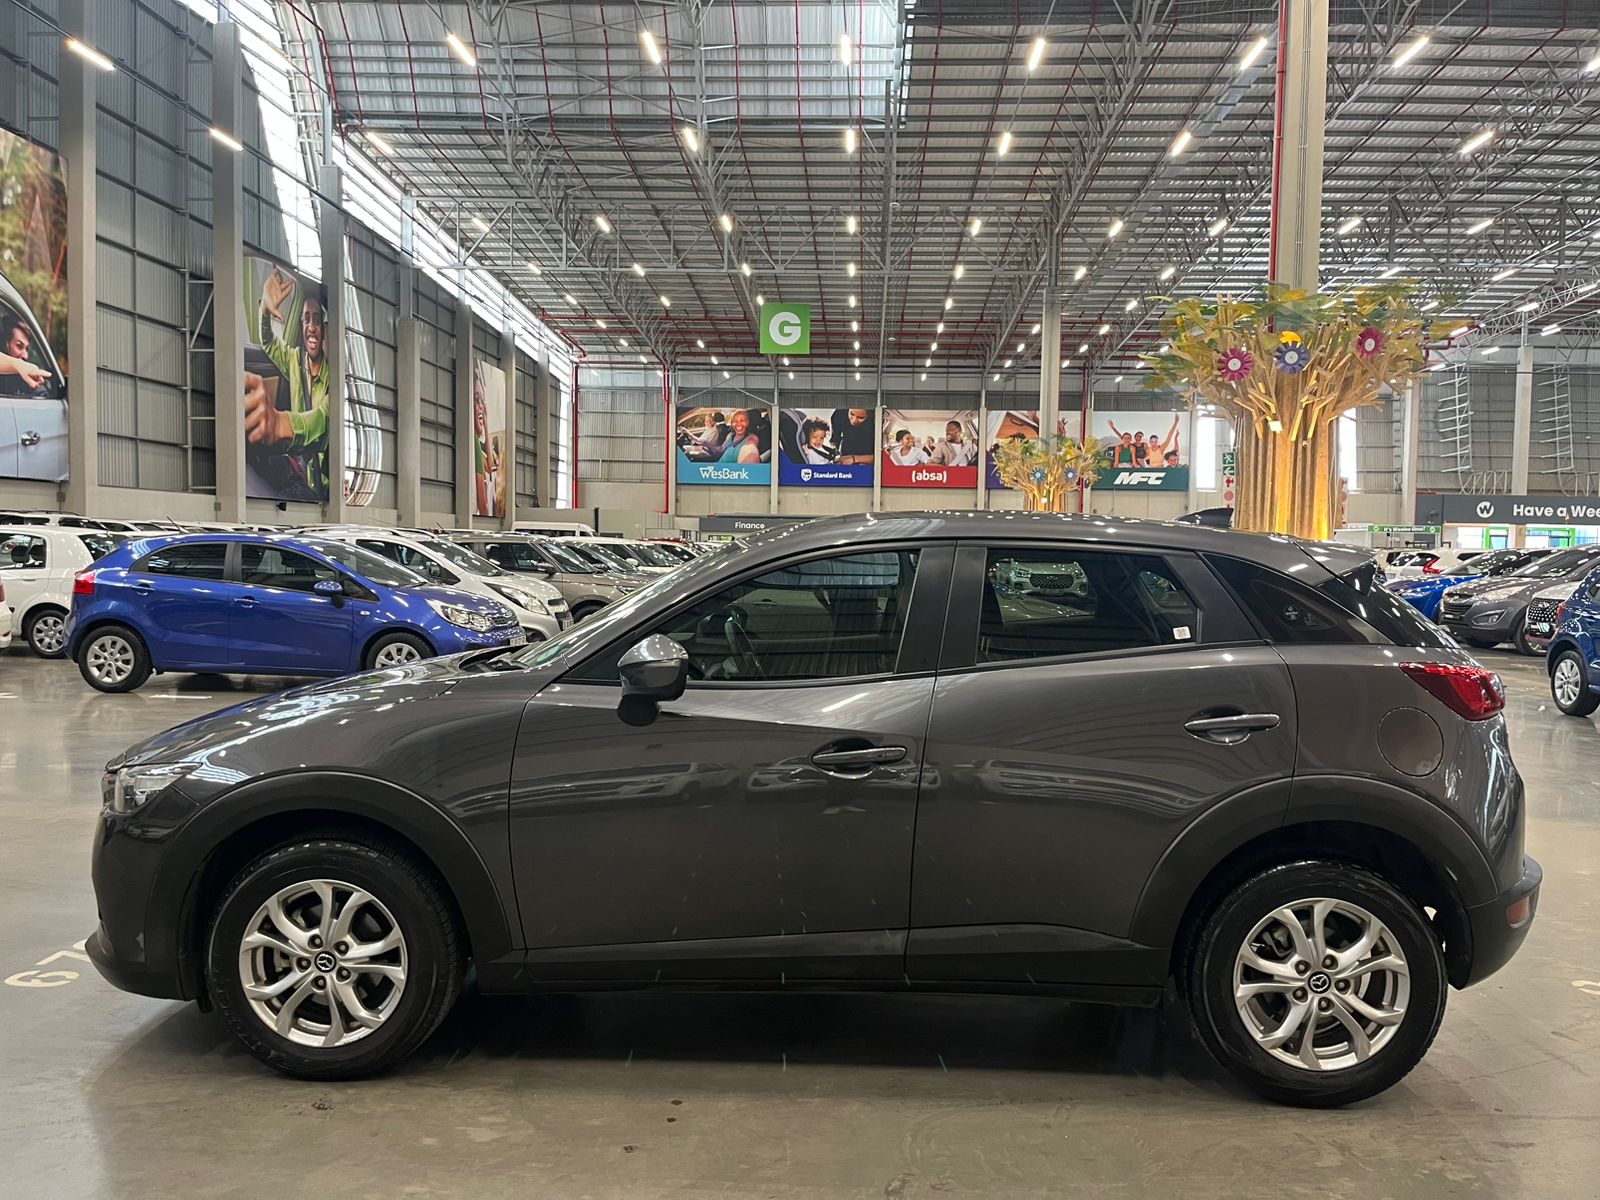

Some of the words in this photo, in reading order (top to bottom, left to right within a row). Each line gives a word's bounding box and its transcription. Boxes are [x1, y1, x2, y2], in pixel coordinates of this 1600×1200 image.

[769, 312, 801, 345] G
[700, 466, 749, 480] WesBank
[813, 471, 838, 479] Standard
[1113, 472, 1166, 485] MFC
[1513, 504, 1554, 517] Have
[1556, 507, 1567, 516] a
